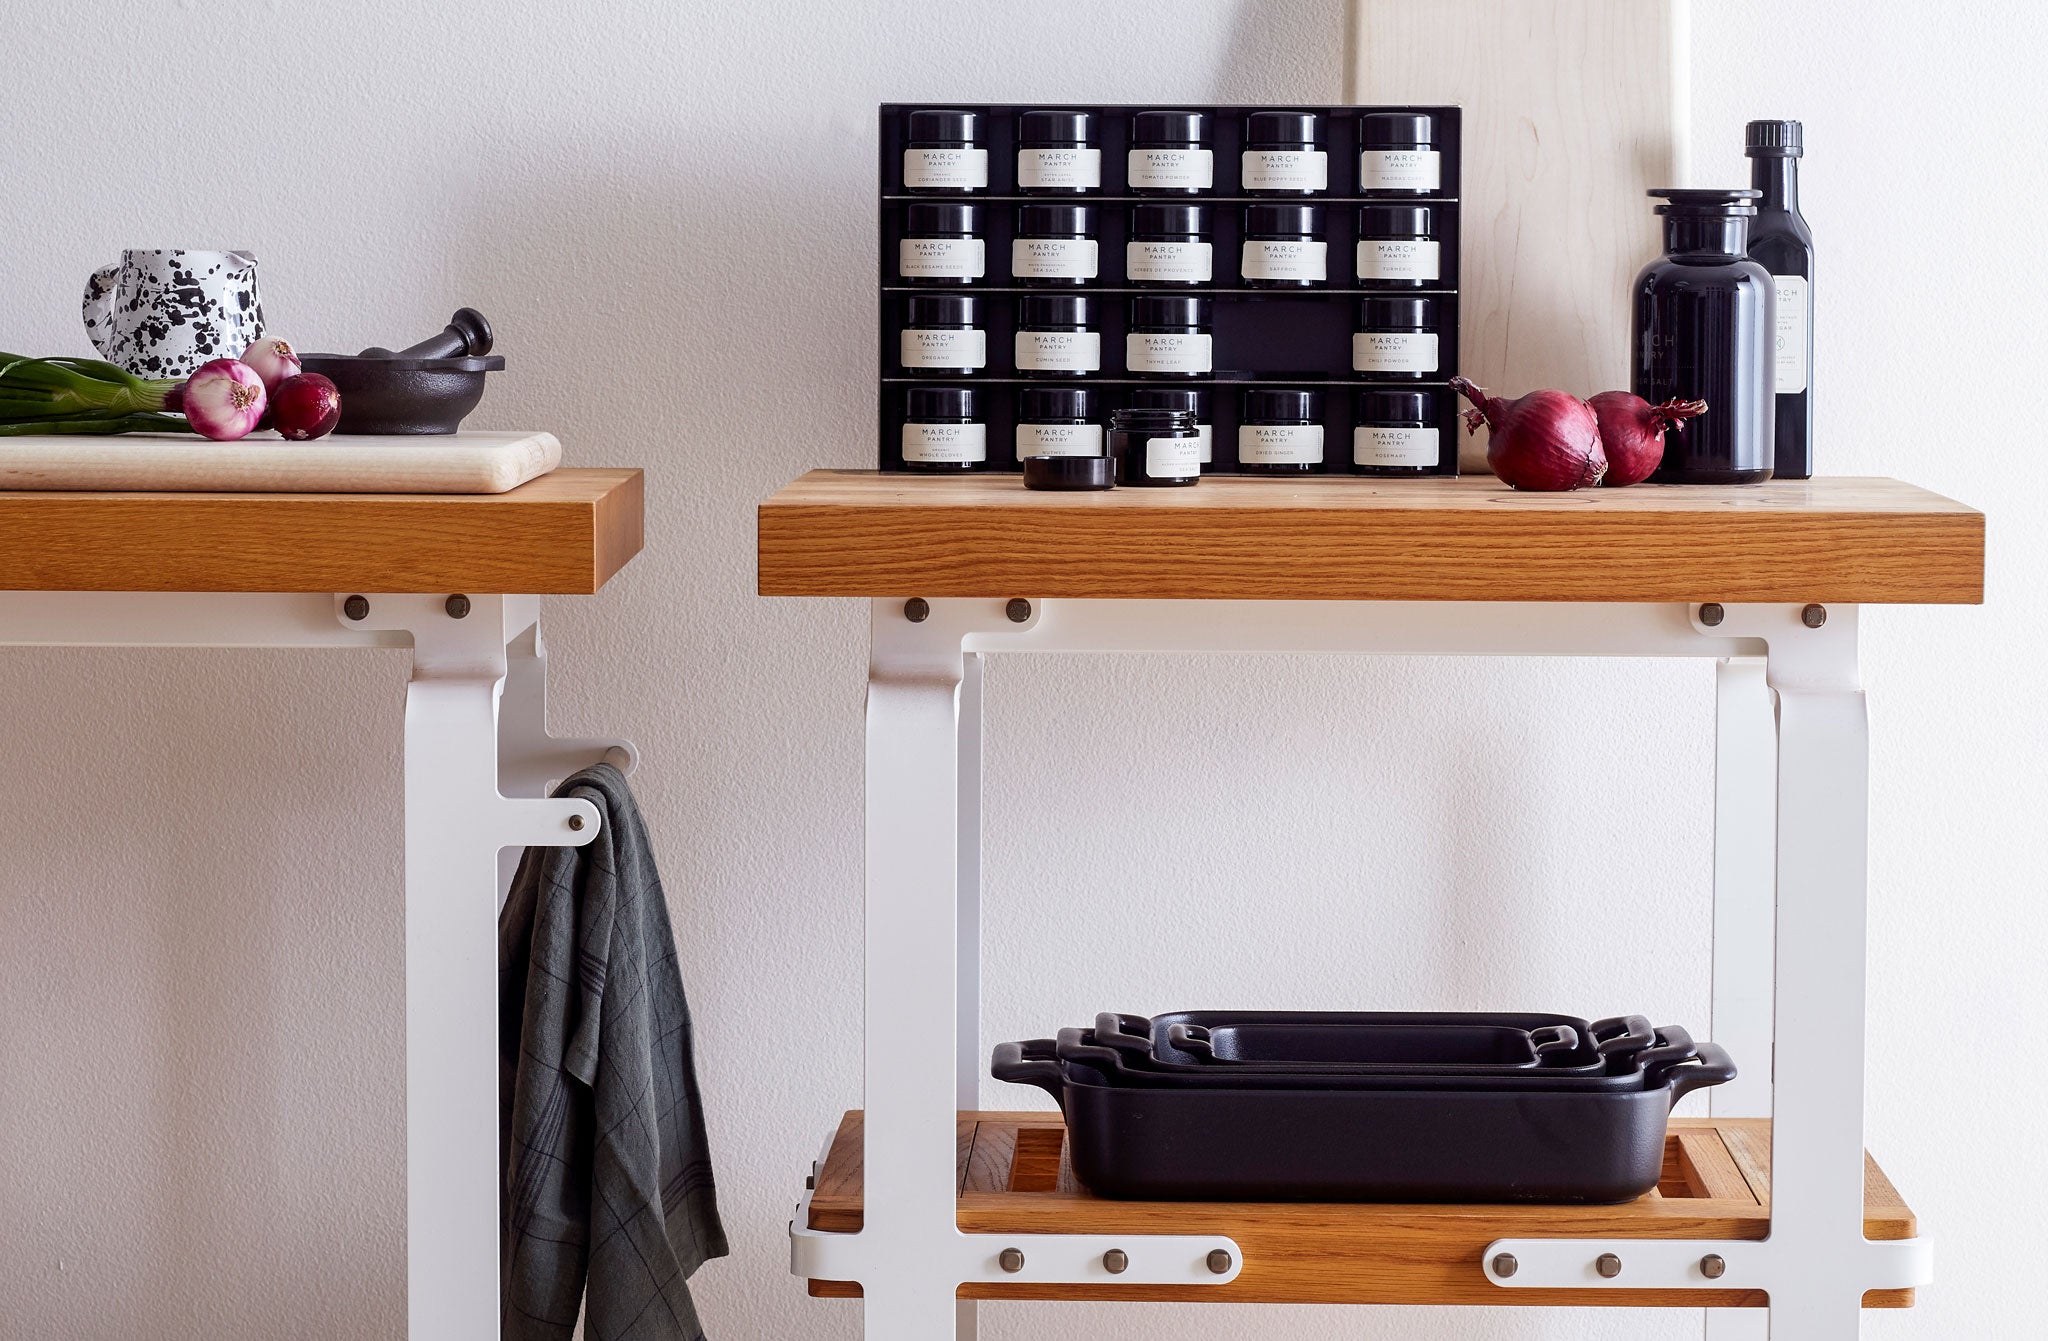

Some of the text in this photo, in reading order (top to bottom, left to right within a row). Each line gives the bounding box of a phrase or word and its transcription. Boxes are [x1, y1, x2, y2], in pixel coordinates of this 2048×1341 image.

[1384, 154, 1423, 162] MARCH
[1028, 243, 1066, 251] MARCH
[1256, 429, 1294, 437] MARCH
